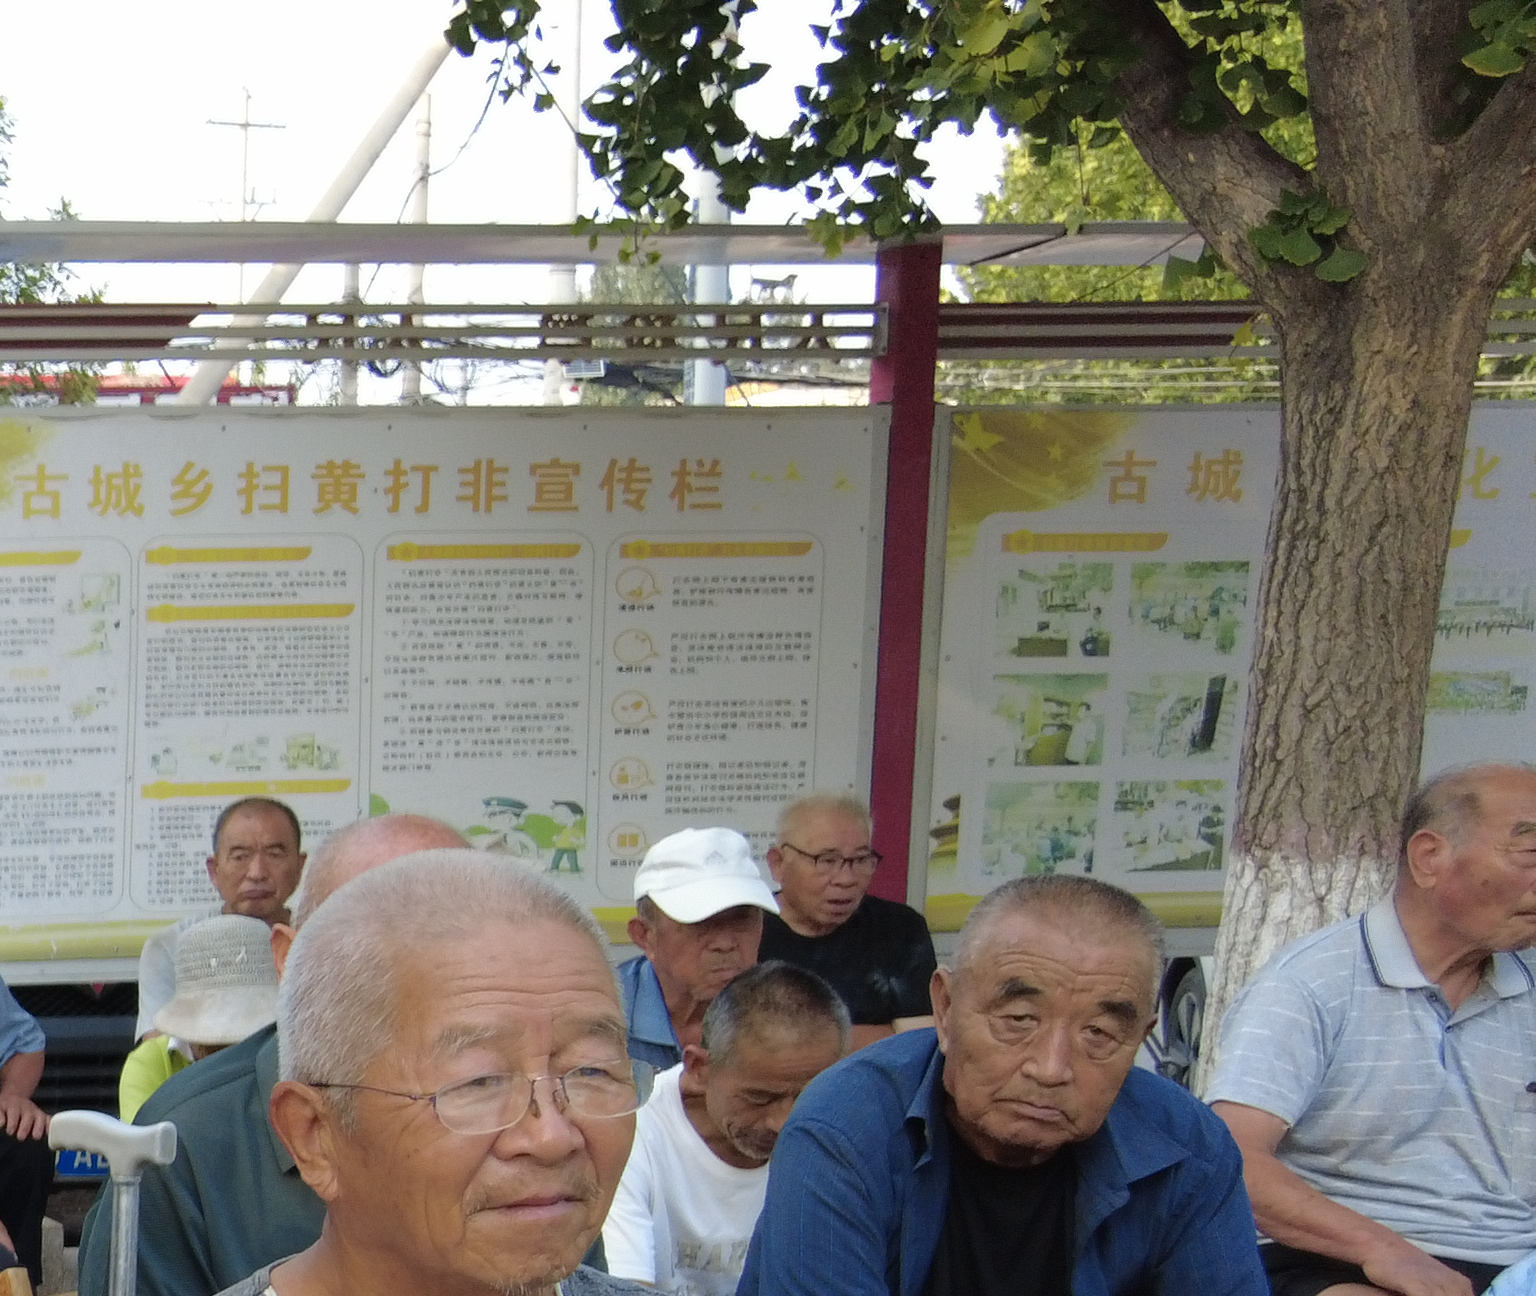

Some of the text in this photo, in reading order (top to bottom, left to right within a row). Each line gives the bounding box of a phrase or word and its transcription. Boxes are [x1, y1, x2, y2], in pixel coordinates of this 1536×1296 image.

[13, 455, 725, 520] 古城乡扫黄打非宣传栏
[1102, 448, 1246, 505] 古城
